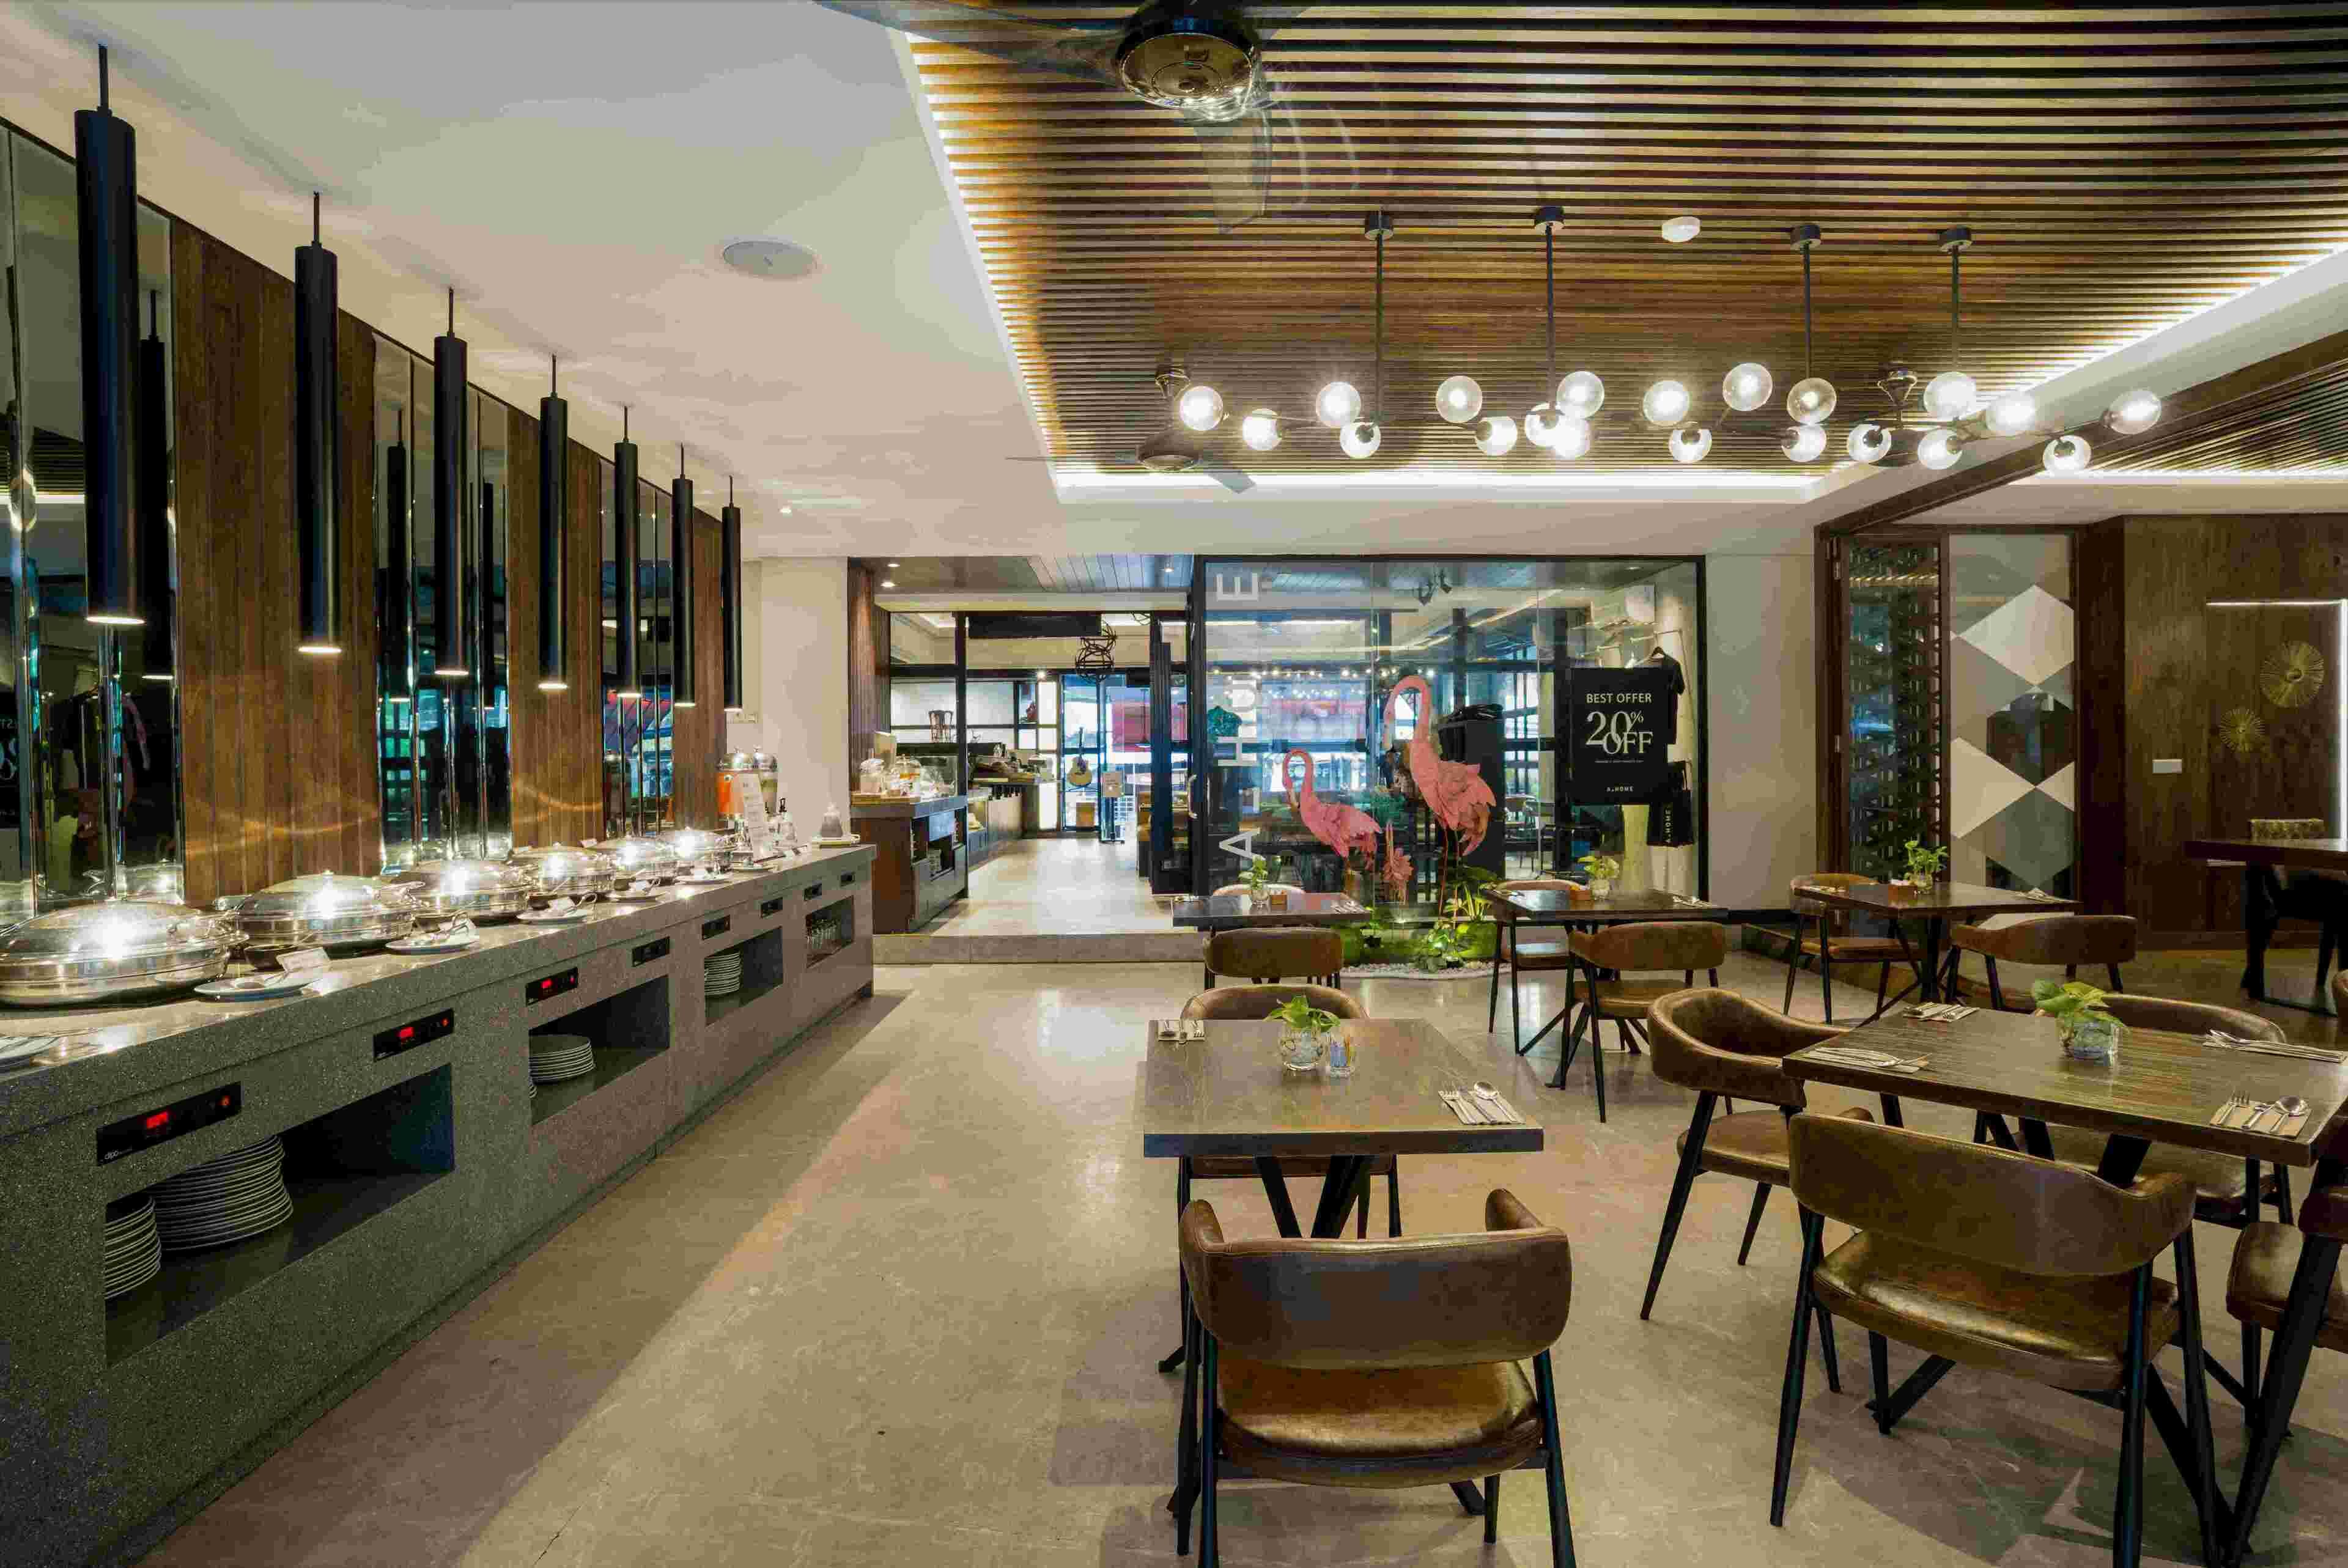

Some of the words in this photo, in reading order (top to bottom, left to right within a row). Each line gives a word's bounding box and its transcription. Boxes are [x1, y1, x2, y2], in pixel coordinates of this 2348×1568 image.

[1586, 693, 1613, 703] BEST
[1617, 693, 1652, 703] OFFER
[1603, 732, 1653, 754] OFF
